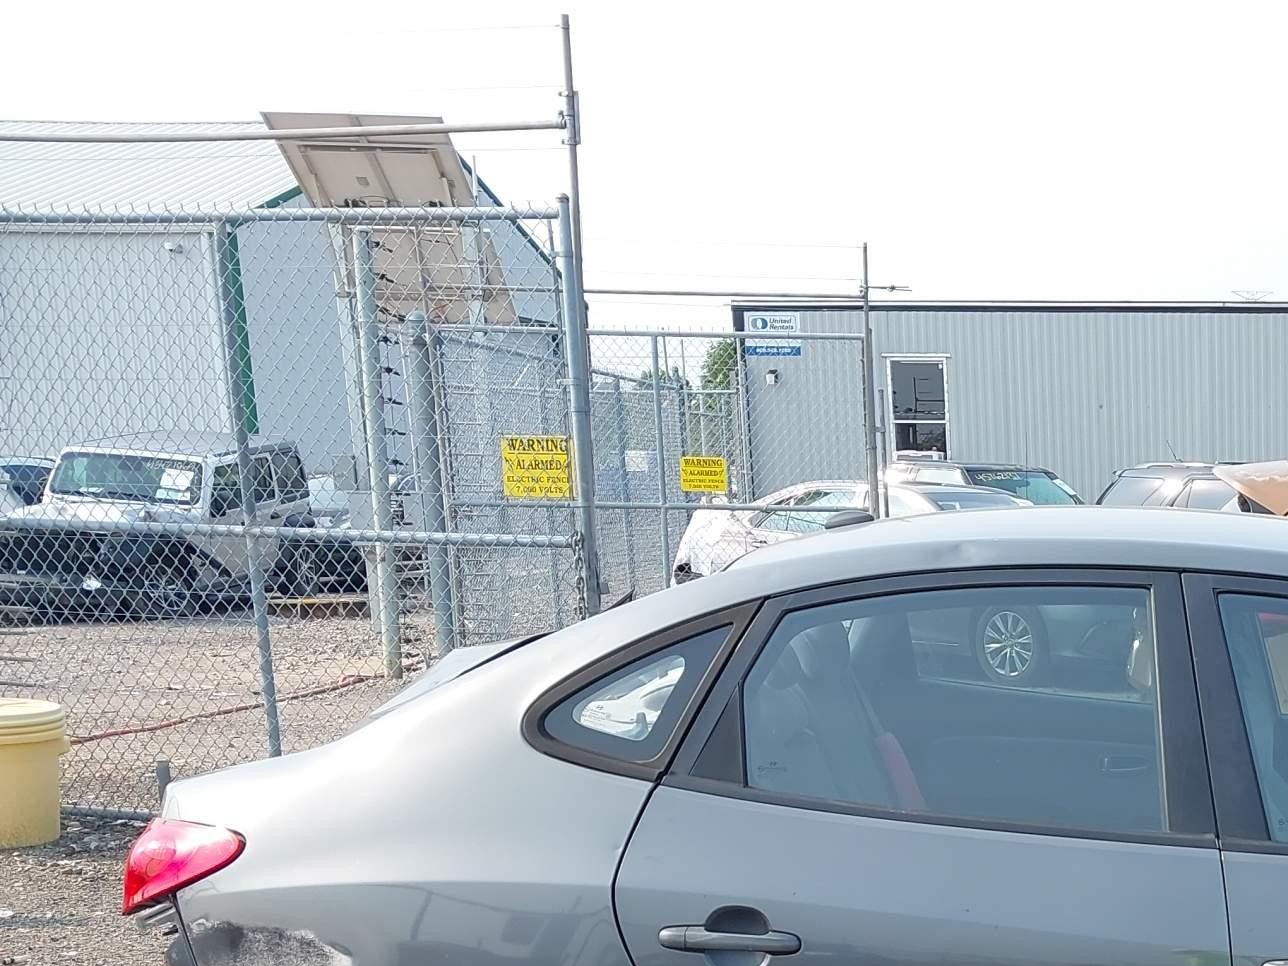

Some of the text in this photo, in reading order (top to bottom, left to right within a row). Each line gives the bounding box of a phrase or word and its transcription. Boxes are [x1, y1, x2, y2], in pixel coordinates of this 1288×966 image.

[515, 459, 562, 471] ALARMED
[683, 458, 723, 467] WARNING
[688, 469, 719, 477] ALARMED
